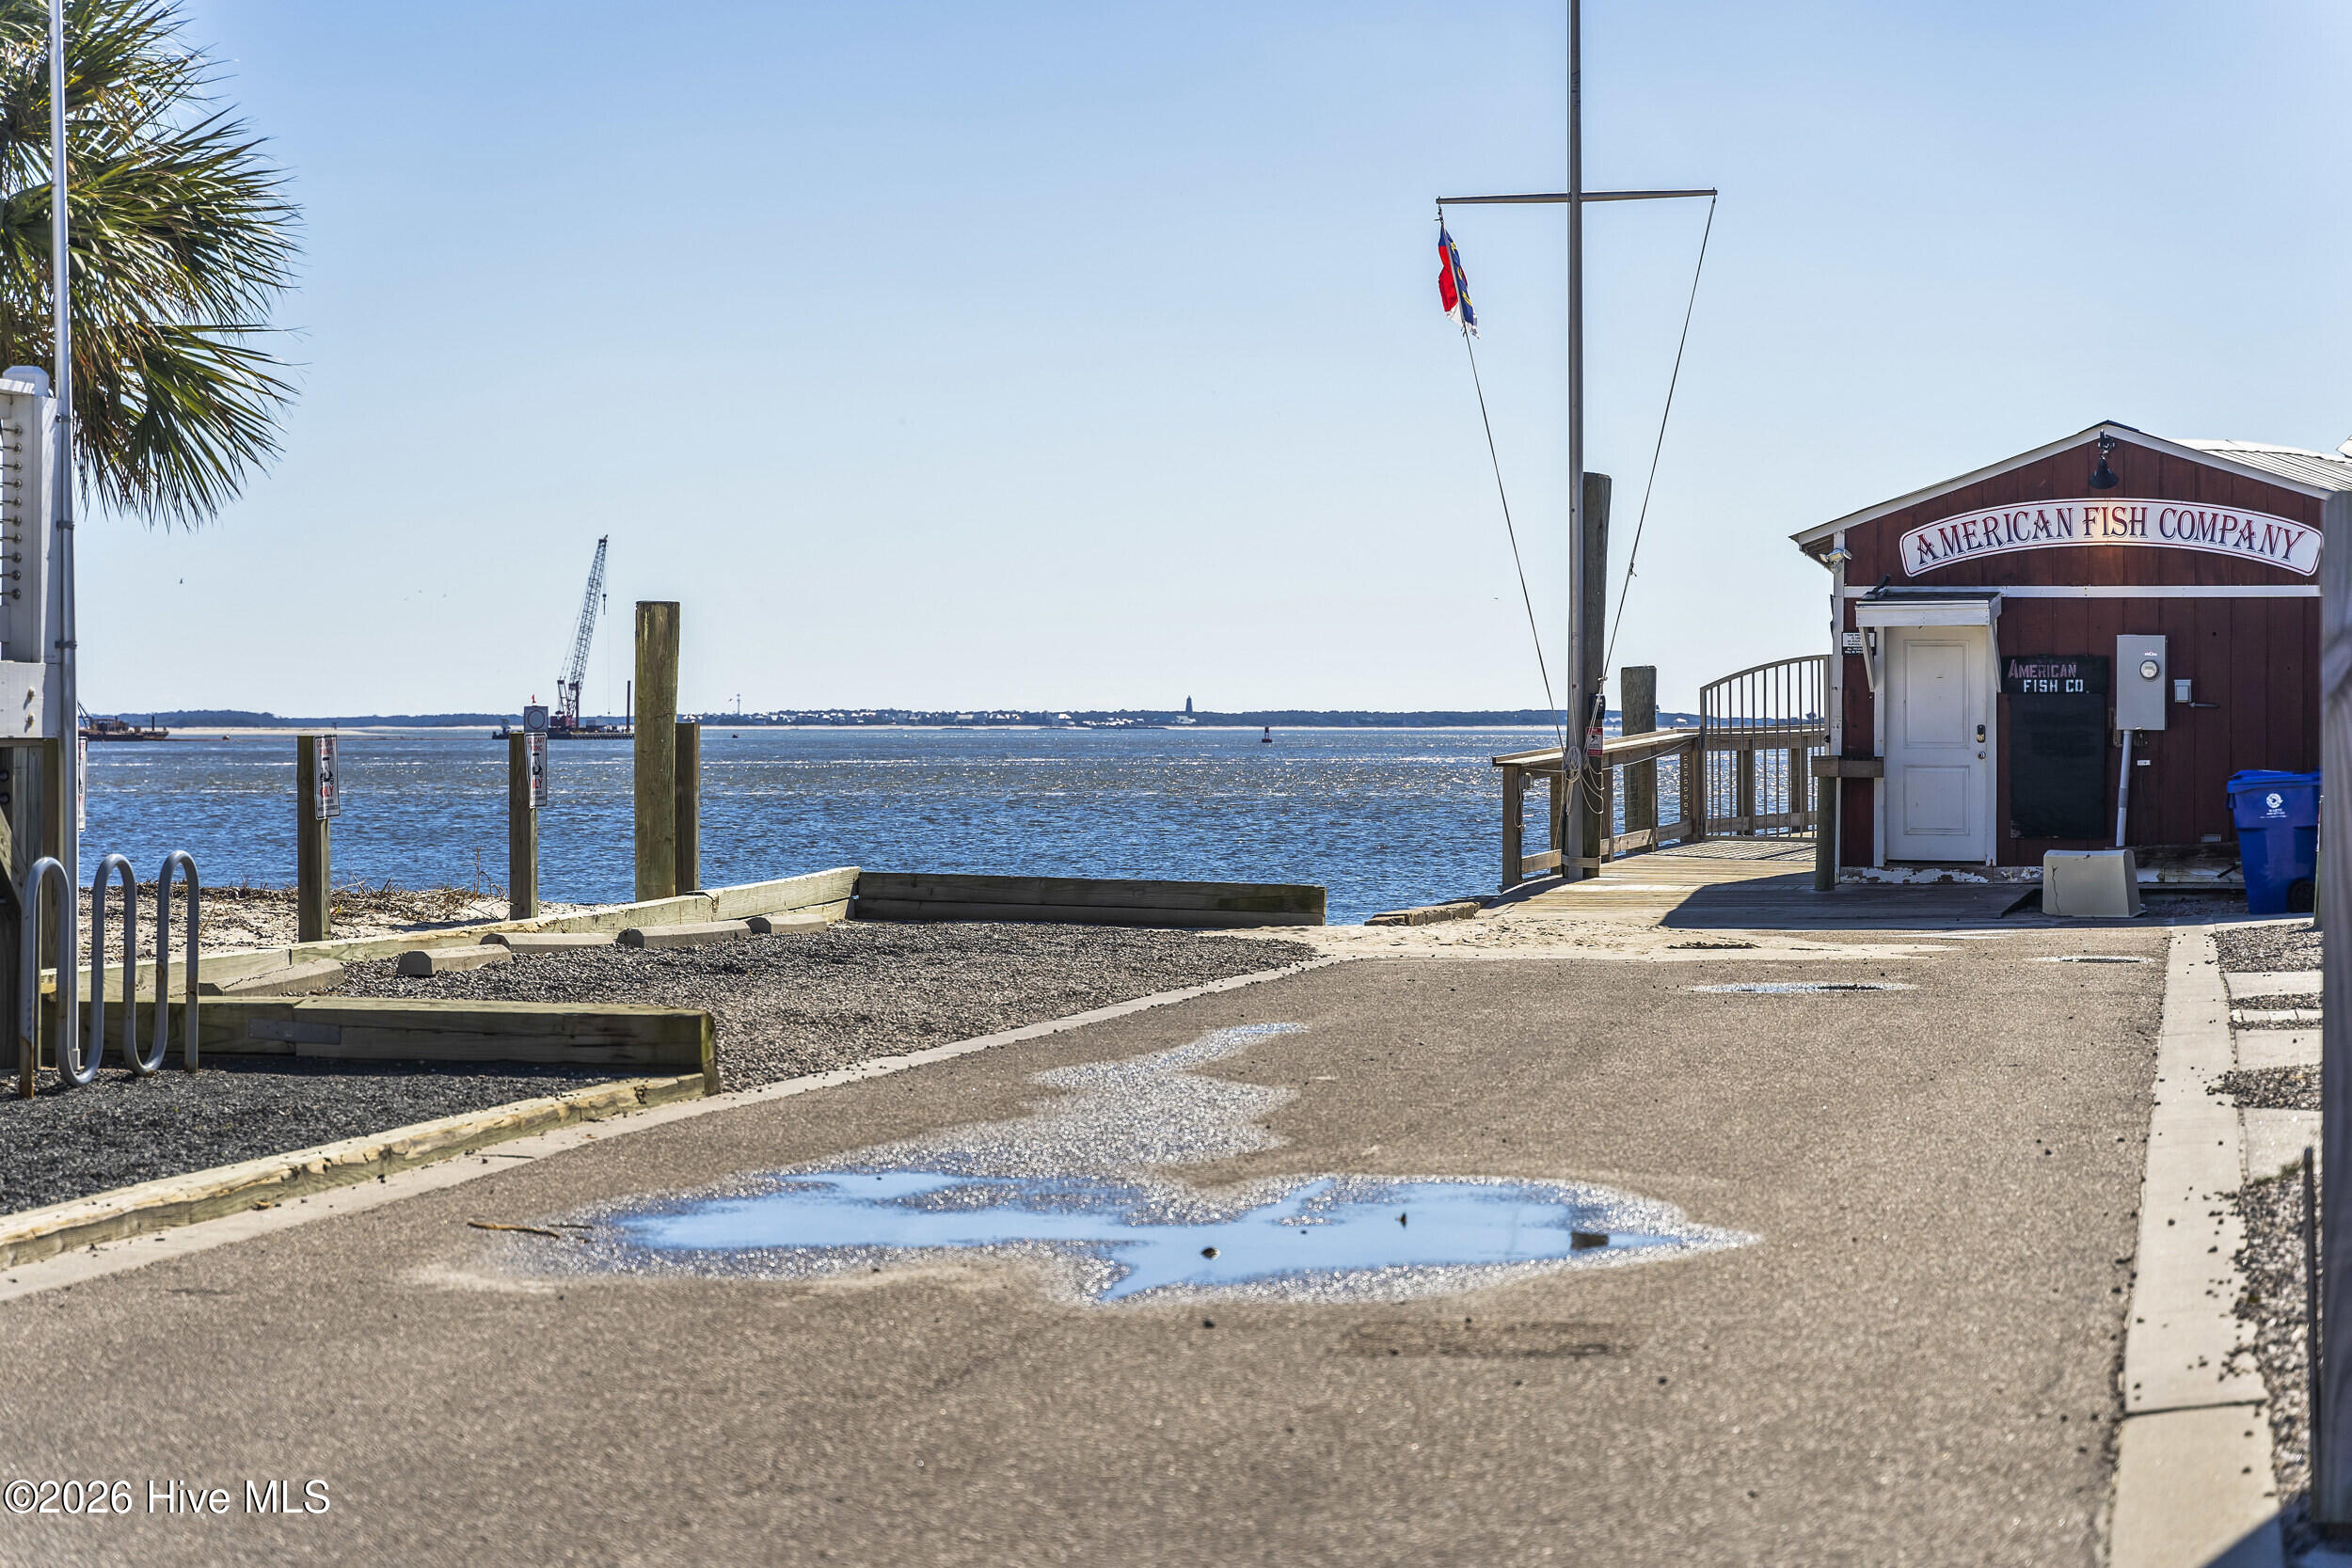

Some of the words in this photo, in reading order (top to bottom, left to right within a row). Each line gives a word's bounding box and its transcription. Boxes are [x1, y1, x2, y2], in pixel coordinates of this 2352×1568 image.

[1915, 506, 2074, 565] AMERICAN
[2082, 506, 2149, 539] FISH
[2158, 506, 2308, 562] COMPANY
[2008, 659, 2077, 678] AMERICAN
[2023, 679, 2058, 693] FISH
